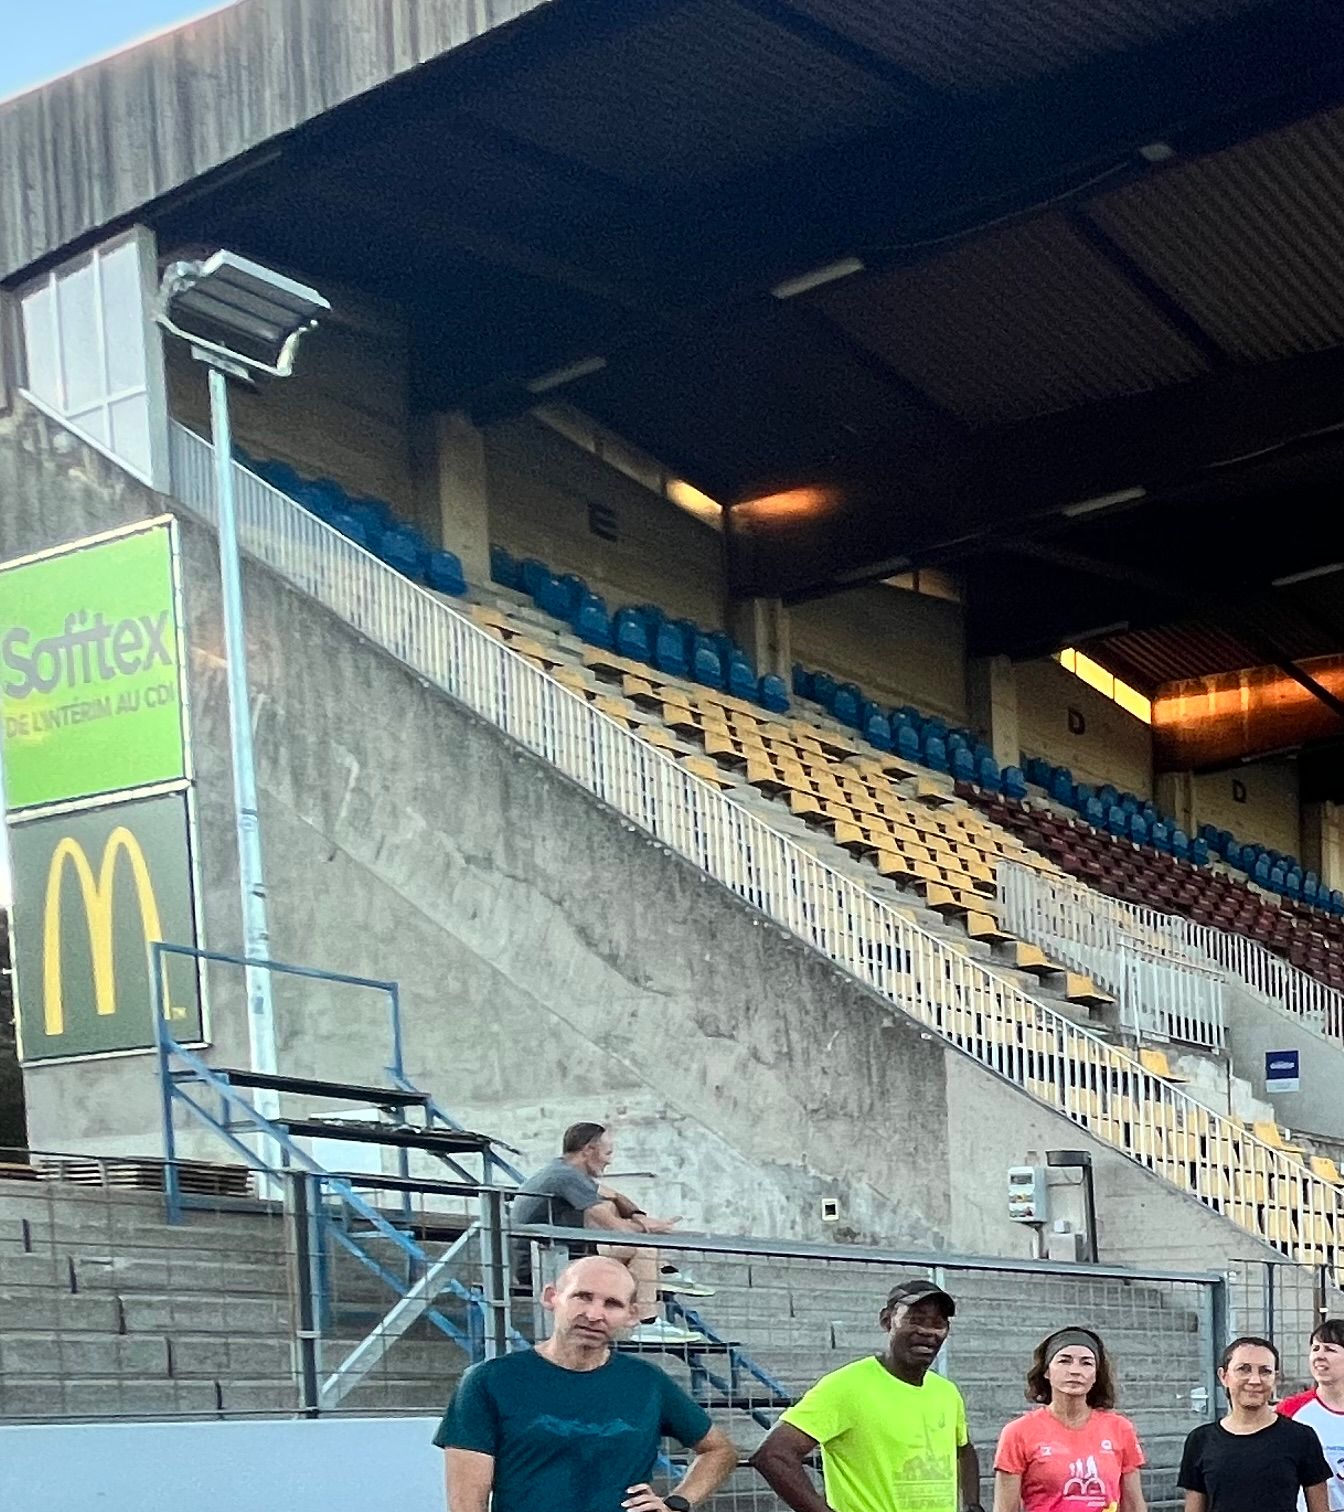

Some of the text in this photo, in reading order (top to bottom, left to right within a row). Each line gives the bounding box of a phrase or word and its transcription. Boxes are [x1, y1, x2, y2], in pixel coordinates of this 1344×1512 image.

[588, 502, 617, 541] E
[3, 609, 173, 699] Sofitex
[6, 713, 31, 738] DE
[116, 690, 141, 715] AU
[1068, 706, 1085, 735] D
[1233, 779, 1247, 803] D
